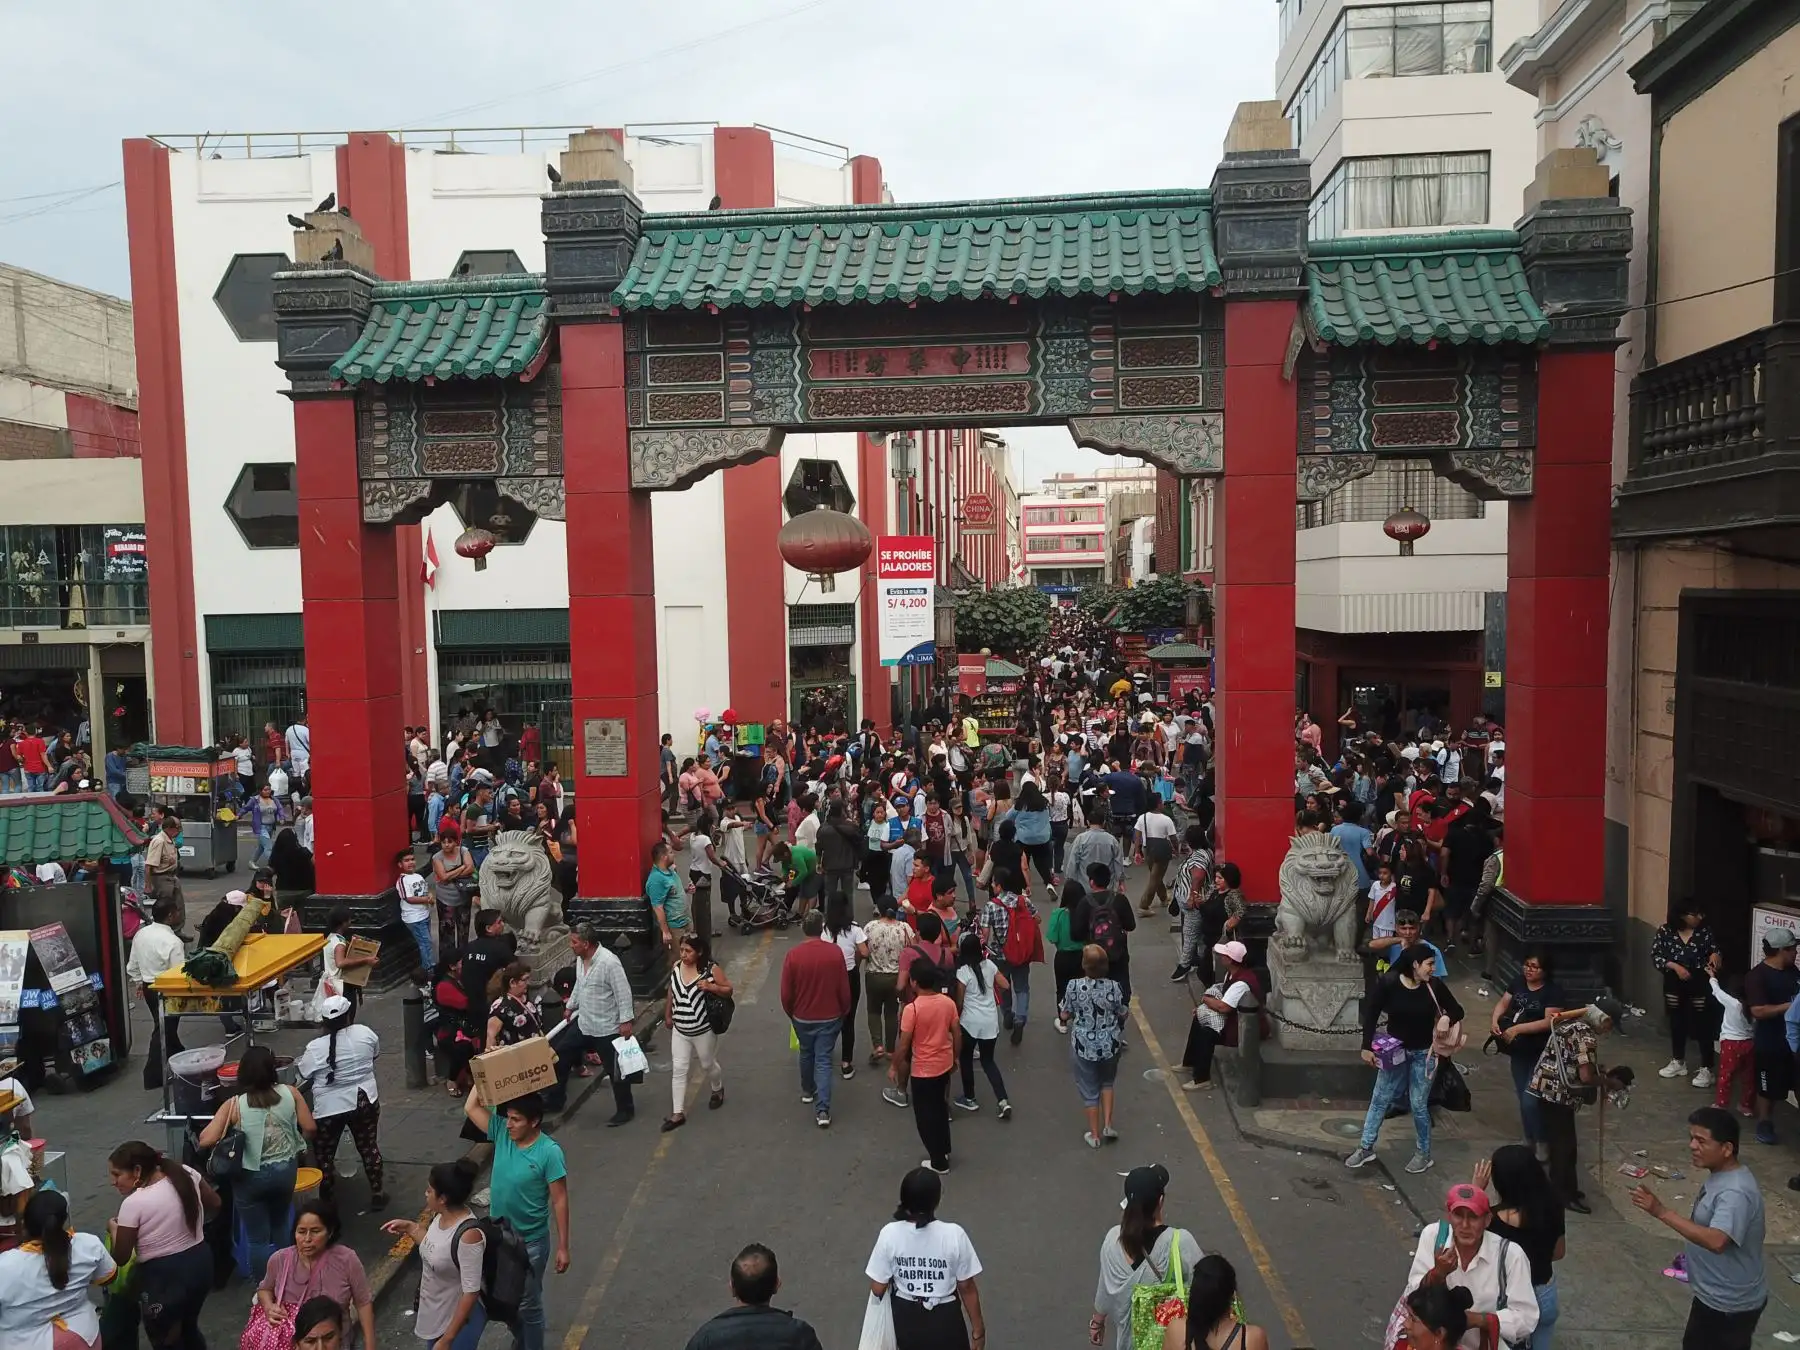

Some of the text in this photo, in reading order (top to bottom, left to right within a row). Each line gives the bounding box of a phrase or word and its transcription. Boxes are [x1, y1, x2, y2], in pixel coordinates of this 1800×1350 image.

[881, 549, 932, 560] SE PROHÍBE
[881, 562, 932, 573] JALADORES
[888, 598, 927, 609] S/ 4,200
[1764, 916, 1796, 929] CHIFA
[24, 990, 39, 999] JW
[41, 990, 53, 1002] JW
[495, 1064, 548, 1090] EUROBISCO
[918, 1258, 927, 1267] DE
[929, 1258, 947, 1268] SODA
[899, 1269, 944, 1280] GABRIELA
